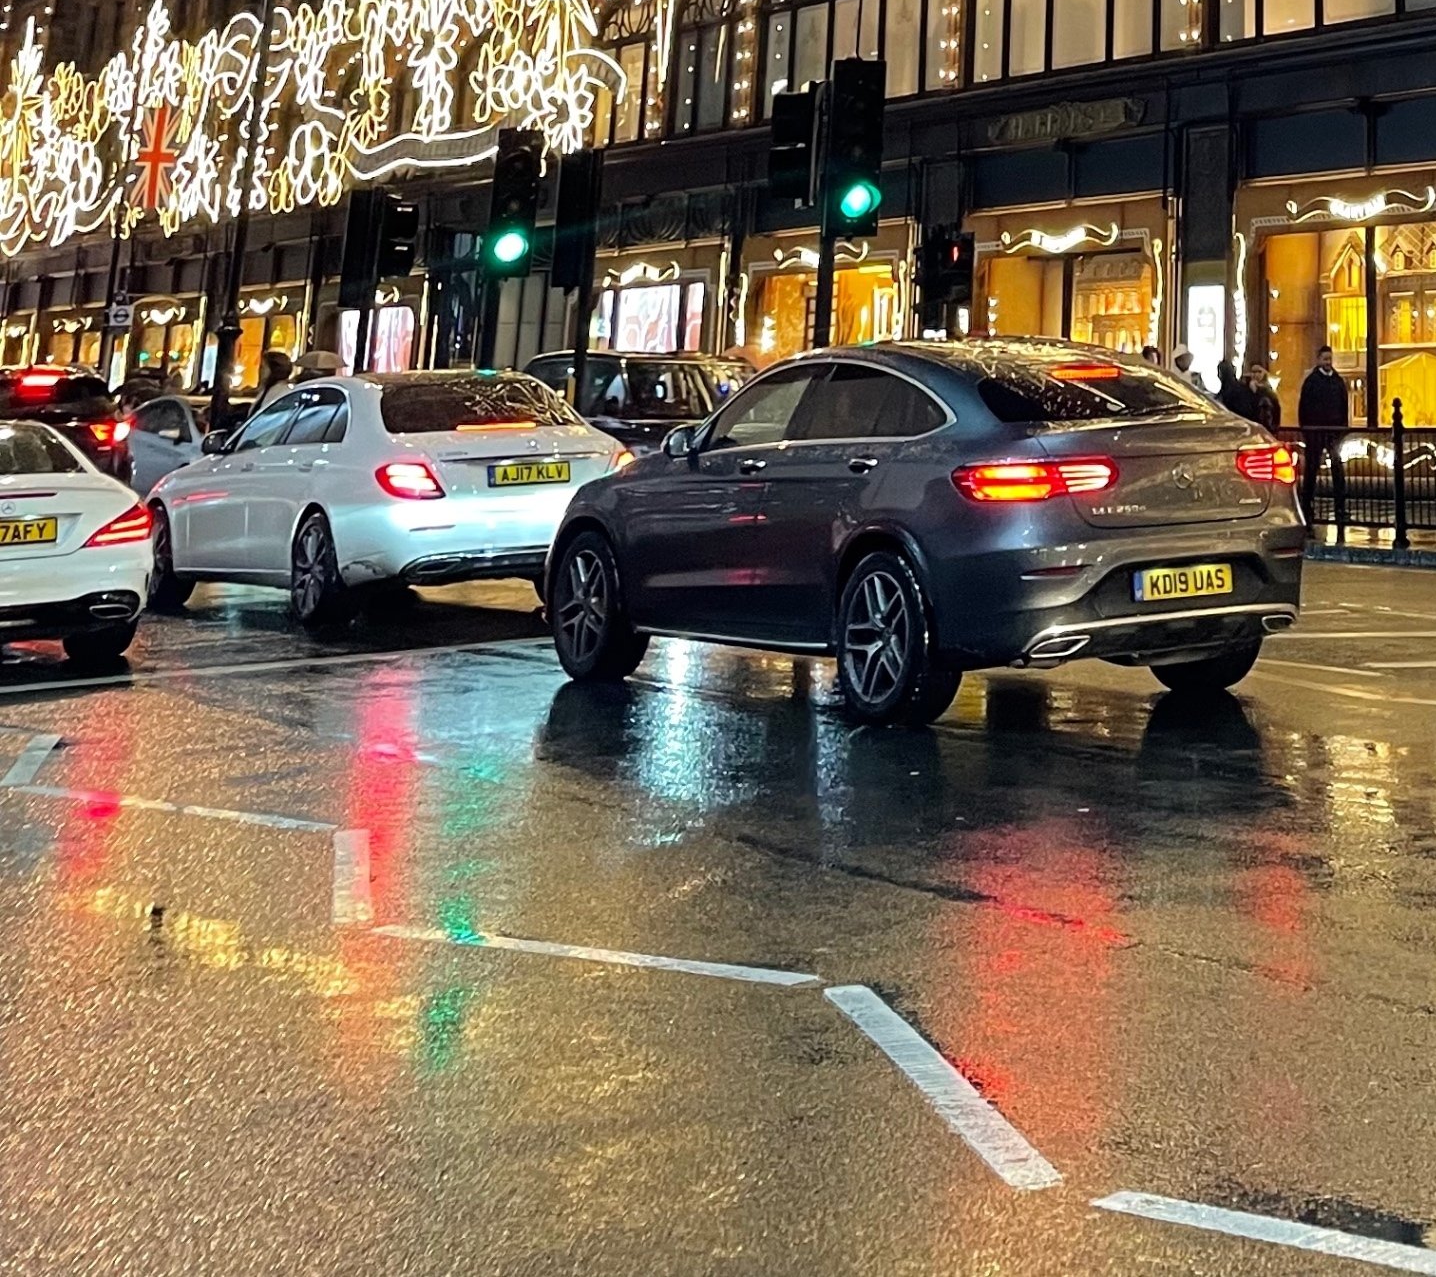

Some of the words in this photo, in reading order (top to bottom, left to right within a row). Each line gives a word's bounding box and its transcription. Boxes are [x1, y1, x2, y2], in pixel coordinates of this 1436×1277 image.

[501, 466, 532, 481] AJ17
[536, 464, 564, 479] KLV
[1150, 573, 1189, 596] KD19
[1193, 568, 1225, 591] UAS
